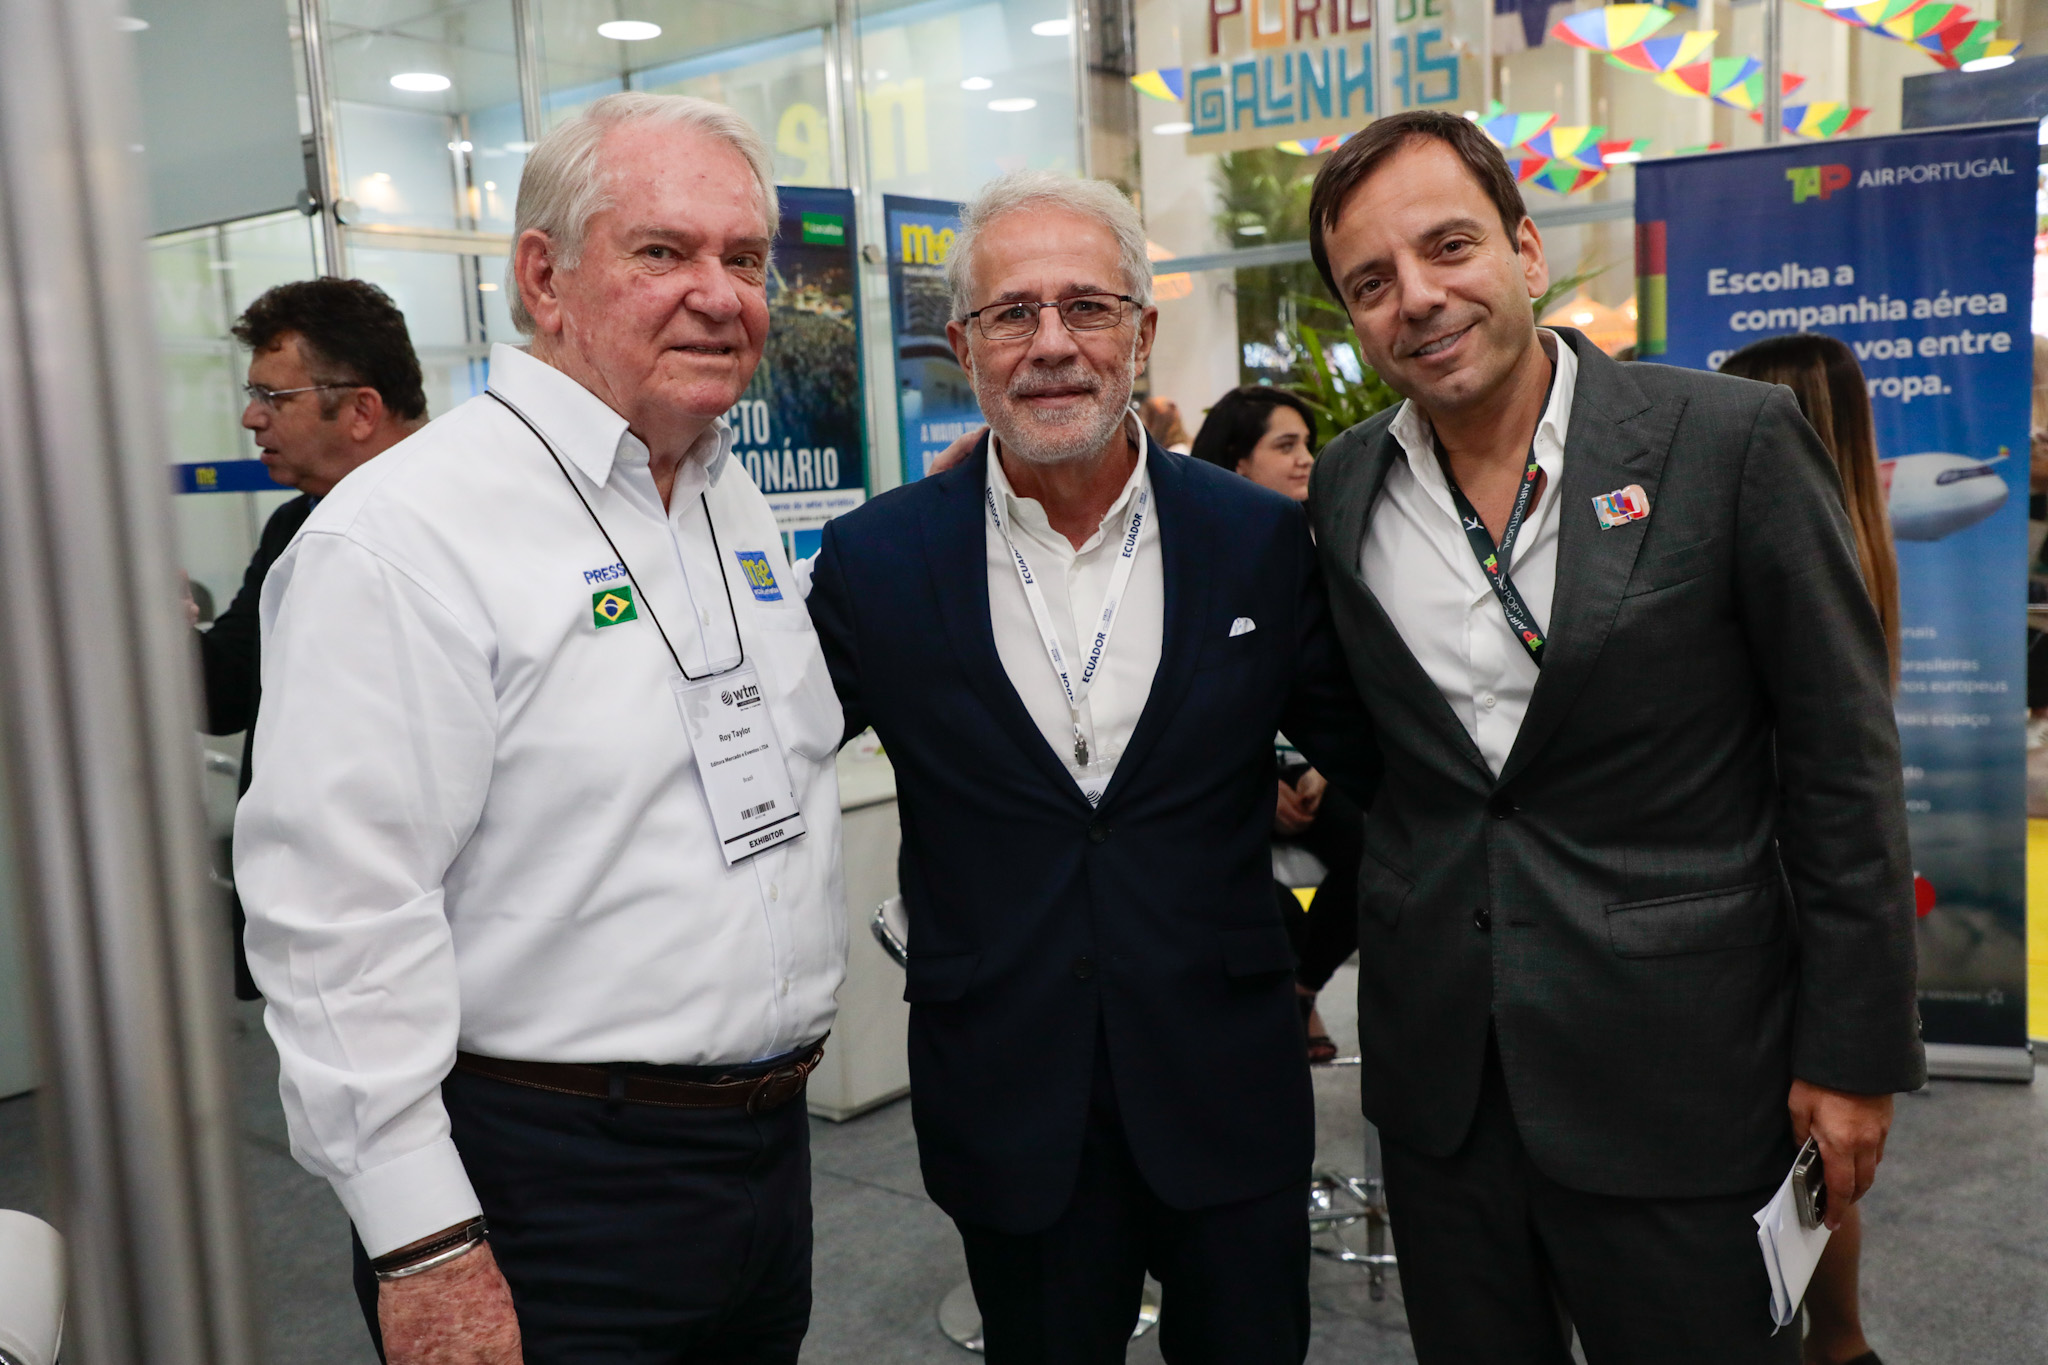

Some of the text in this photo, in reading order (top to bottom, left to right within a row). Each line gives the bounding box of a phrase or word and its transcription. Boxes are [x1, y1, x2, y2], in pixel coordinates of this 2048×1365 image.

[1786, 164, 1852, 203] TAP
[1707, 263, 1854, 295] Escolha a
[1730, 289, 2008, 332] companhia aérea
[1853, 329, 2011, 361] voa entre
[1868, 375, 1951, 403] ropa.
[986, 486, 1001, 529] ECUADOR
[1122, 513, 1143, 558] ECUADOR
[583, 562, 628, 585] PRESS
[1082, 632, 1107, 684] ECUADOR
[733, 684, 759, 701] wtm
[718, 727, 751, 742] Roy Taylor
[749, 828, 785, 849] EXHIBITOR
